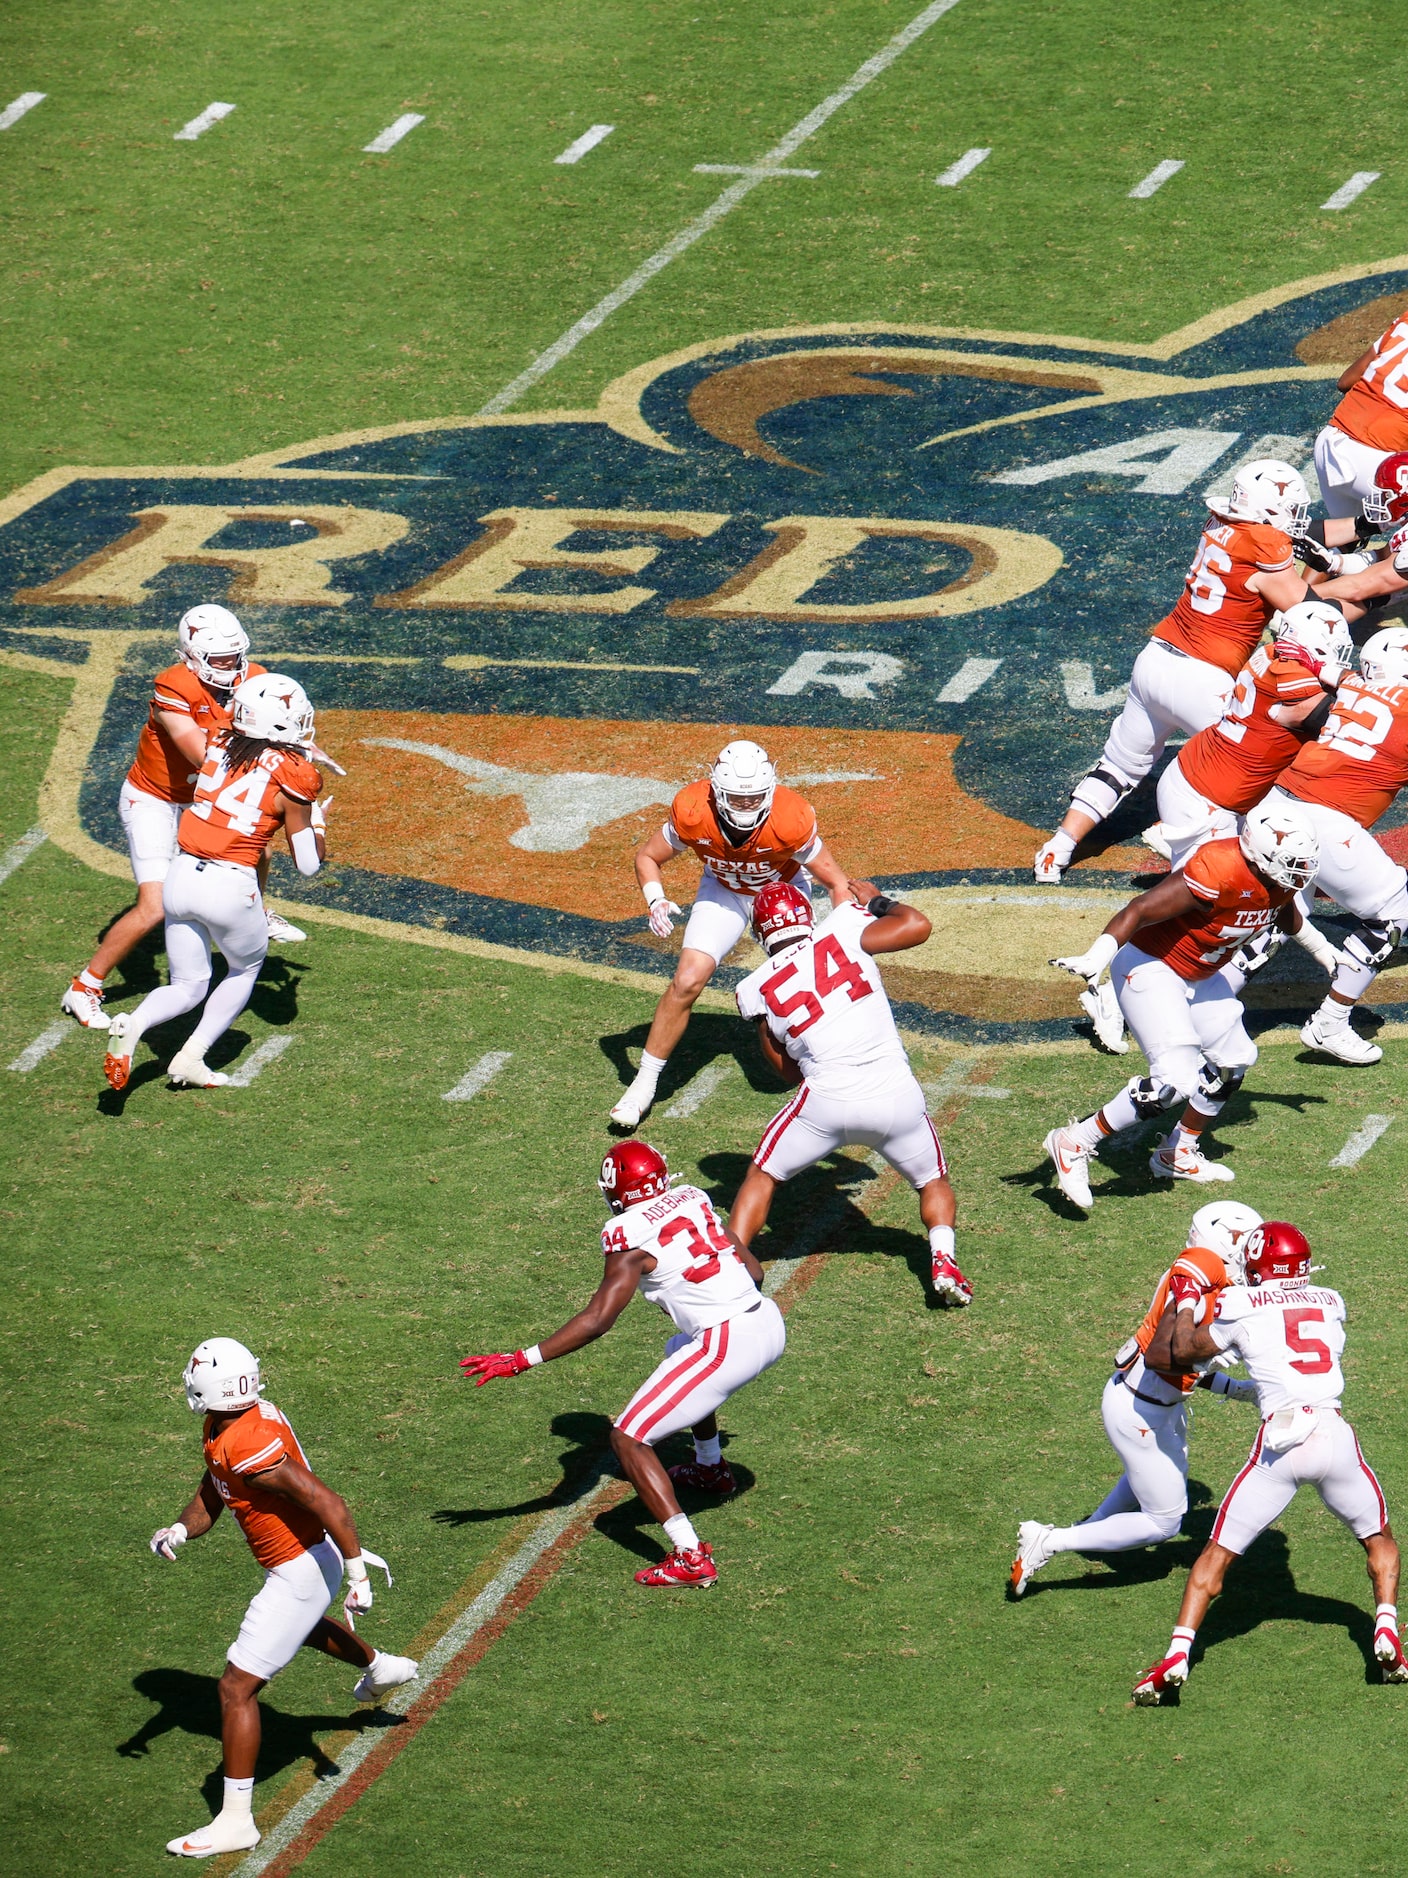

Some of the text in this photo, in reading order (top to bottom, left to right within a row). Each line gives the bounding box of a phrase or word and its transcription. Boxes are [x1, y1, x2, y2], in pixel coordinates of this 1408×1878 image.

[14, 504, 1066, 625] RED
[1318, 687, 1394, 762] 52
[188, 744, 273, 837] 24
[703, 854, 772, 874] TEXAS
[773, 909, 797, 928] 54
[1233, 905, 1281, 927] TEXAS
[760, 933, 873, 1039] 54
[643, 1177, 665, 1197] 34
[1298, 1260, 1307, 1275] 5
[1247, 1290, 1338, 1309] WASHINGTON
[1282, 1307, 1333, 1375] 5
